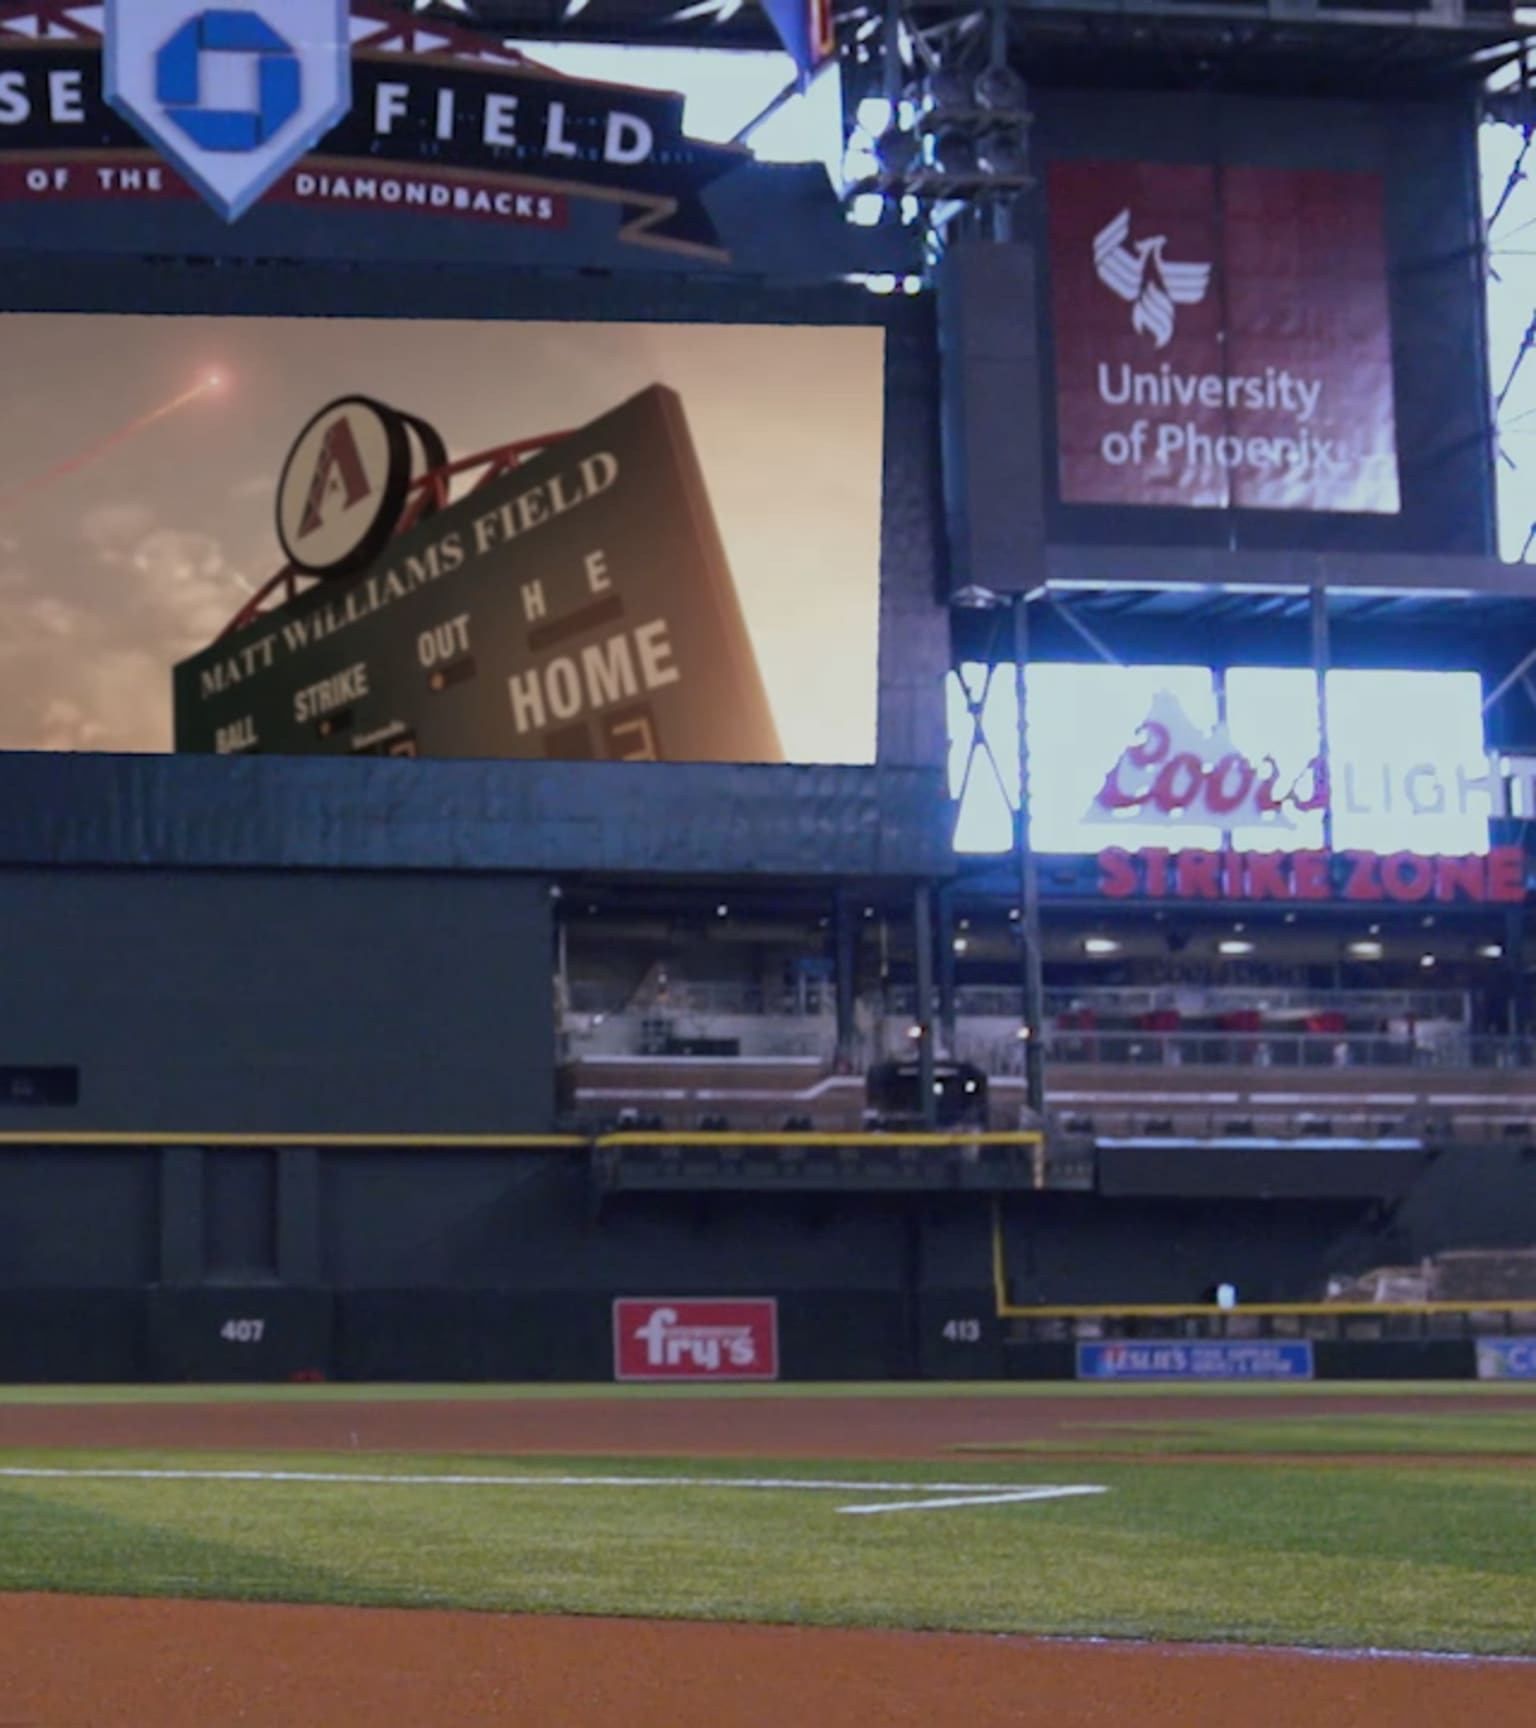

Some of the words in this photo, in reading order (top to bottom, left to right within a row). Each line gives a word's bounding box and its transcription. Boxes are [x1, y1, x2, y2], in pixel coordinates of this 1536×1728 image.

[375, 82, 654, 165] FIELD
[26, 168, 70, 191] OF
[97, 167, 163, 191] THE
[295, 173, 554, 220] DIAMONDBACKS
[1097, 362, 1322, 423] University
[1101, 419, 1149, 465] of
[1157, 422, 1335, 469] Phoenix
[200, 633, 279, 699] MATT
[282, 533, 465, 653] WILLIAMS
[471, 450, 620, 556] FIELD
[521, 579, 548, 623] H
[583, 549, 612, 592] E
[417, 613, 470, 667] OUT
[293, 661, 369, 724] STRIKE
[508, 617, 681, 735] HOME
[215, 715, 258, 755] BALL
[1096, 845, 1332, 899] STRIKE
[1341, 846, 1529, 902] ZONE
[219, 1318, 265, 1342] 407
[633, 1307, 756, 1371] fry's
[942, 1318, 981, 1342] 413
